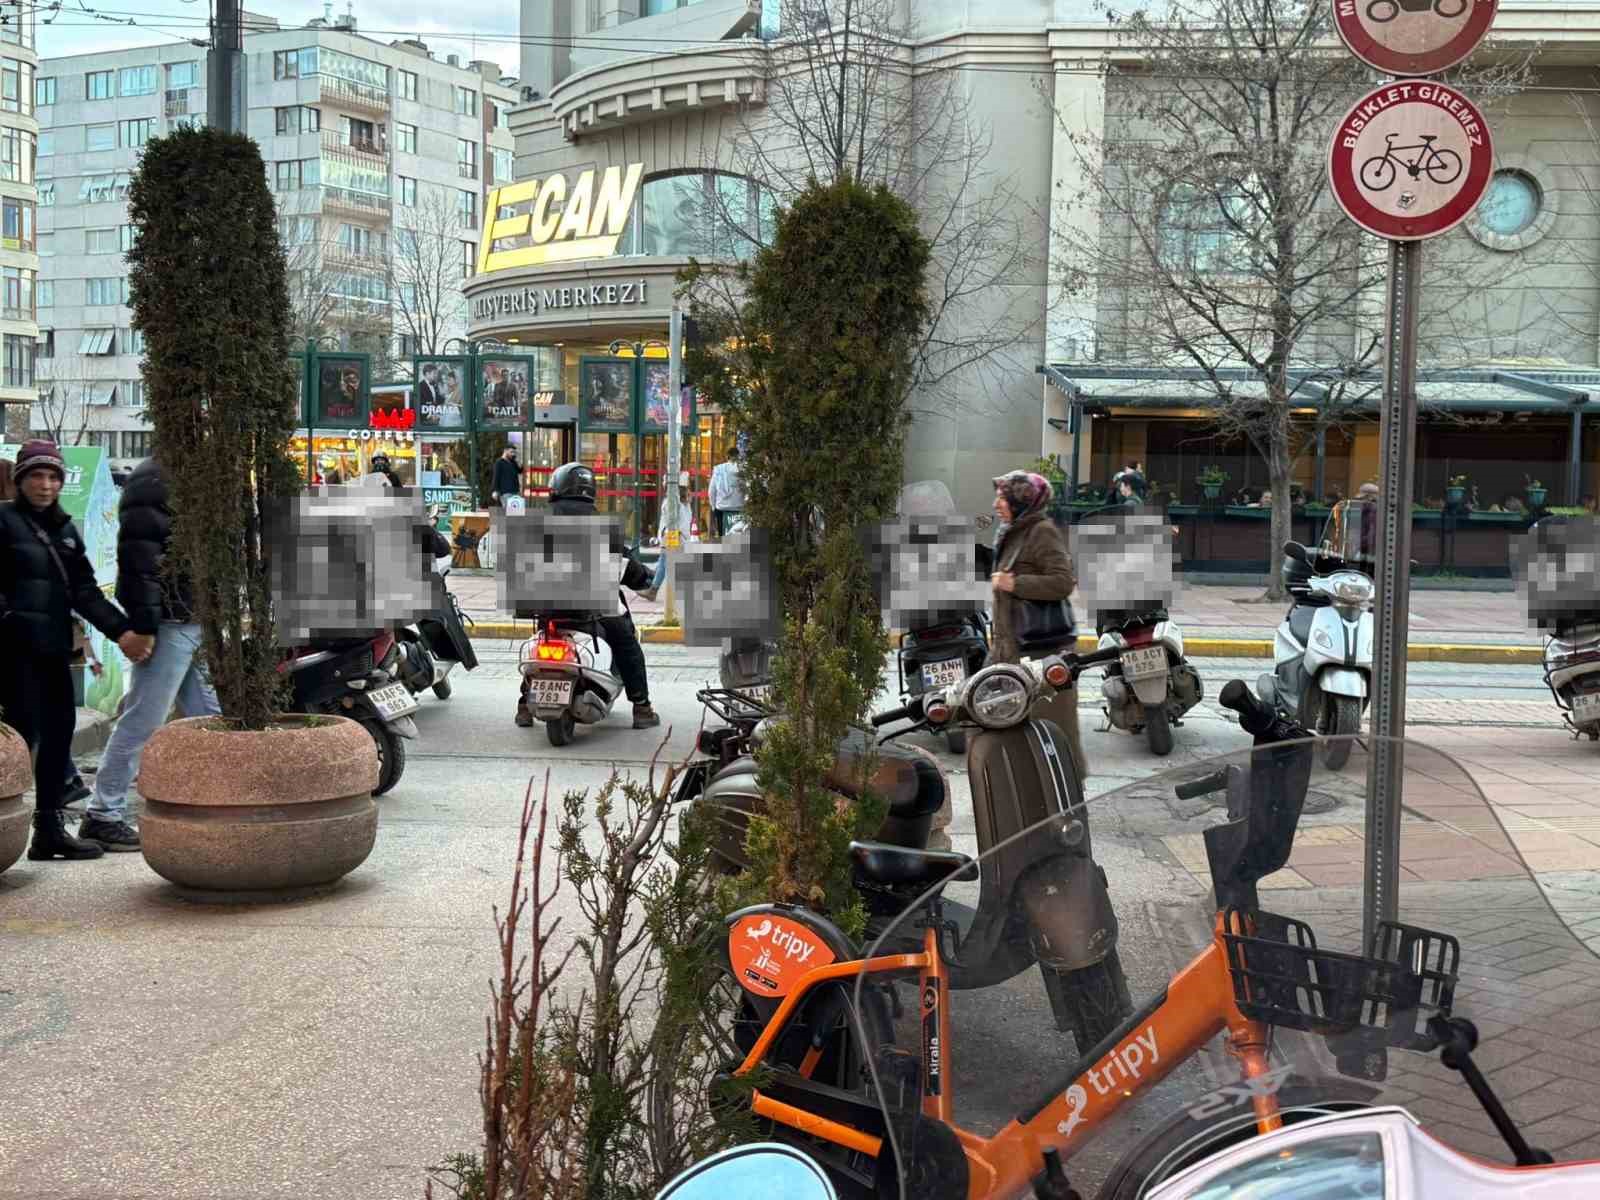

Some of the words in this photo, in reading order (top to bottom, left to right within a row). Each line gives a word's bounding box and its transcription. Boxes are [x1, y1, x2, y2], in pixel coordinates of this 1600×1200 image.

[1343, 86, 1412, 149] BİSİKLET
[1418, 86, 1482, 147] GİREMEZ
[543, 279, 647, 309] MERKEZİ
[771, 925, 815, 962] tripy
[1087, 1025, 1160, 1096] tripy
